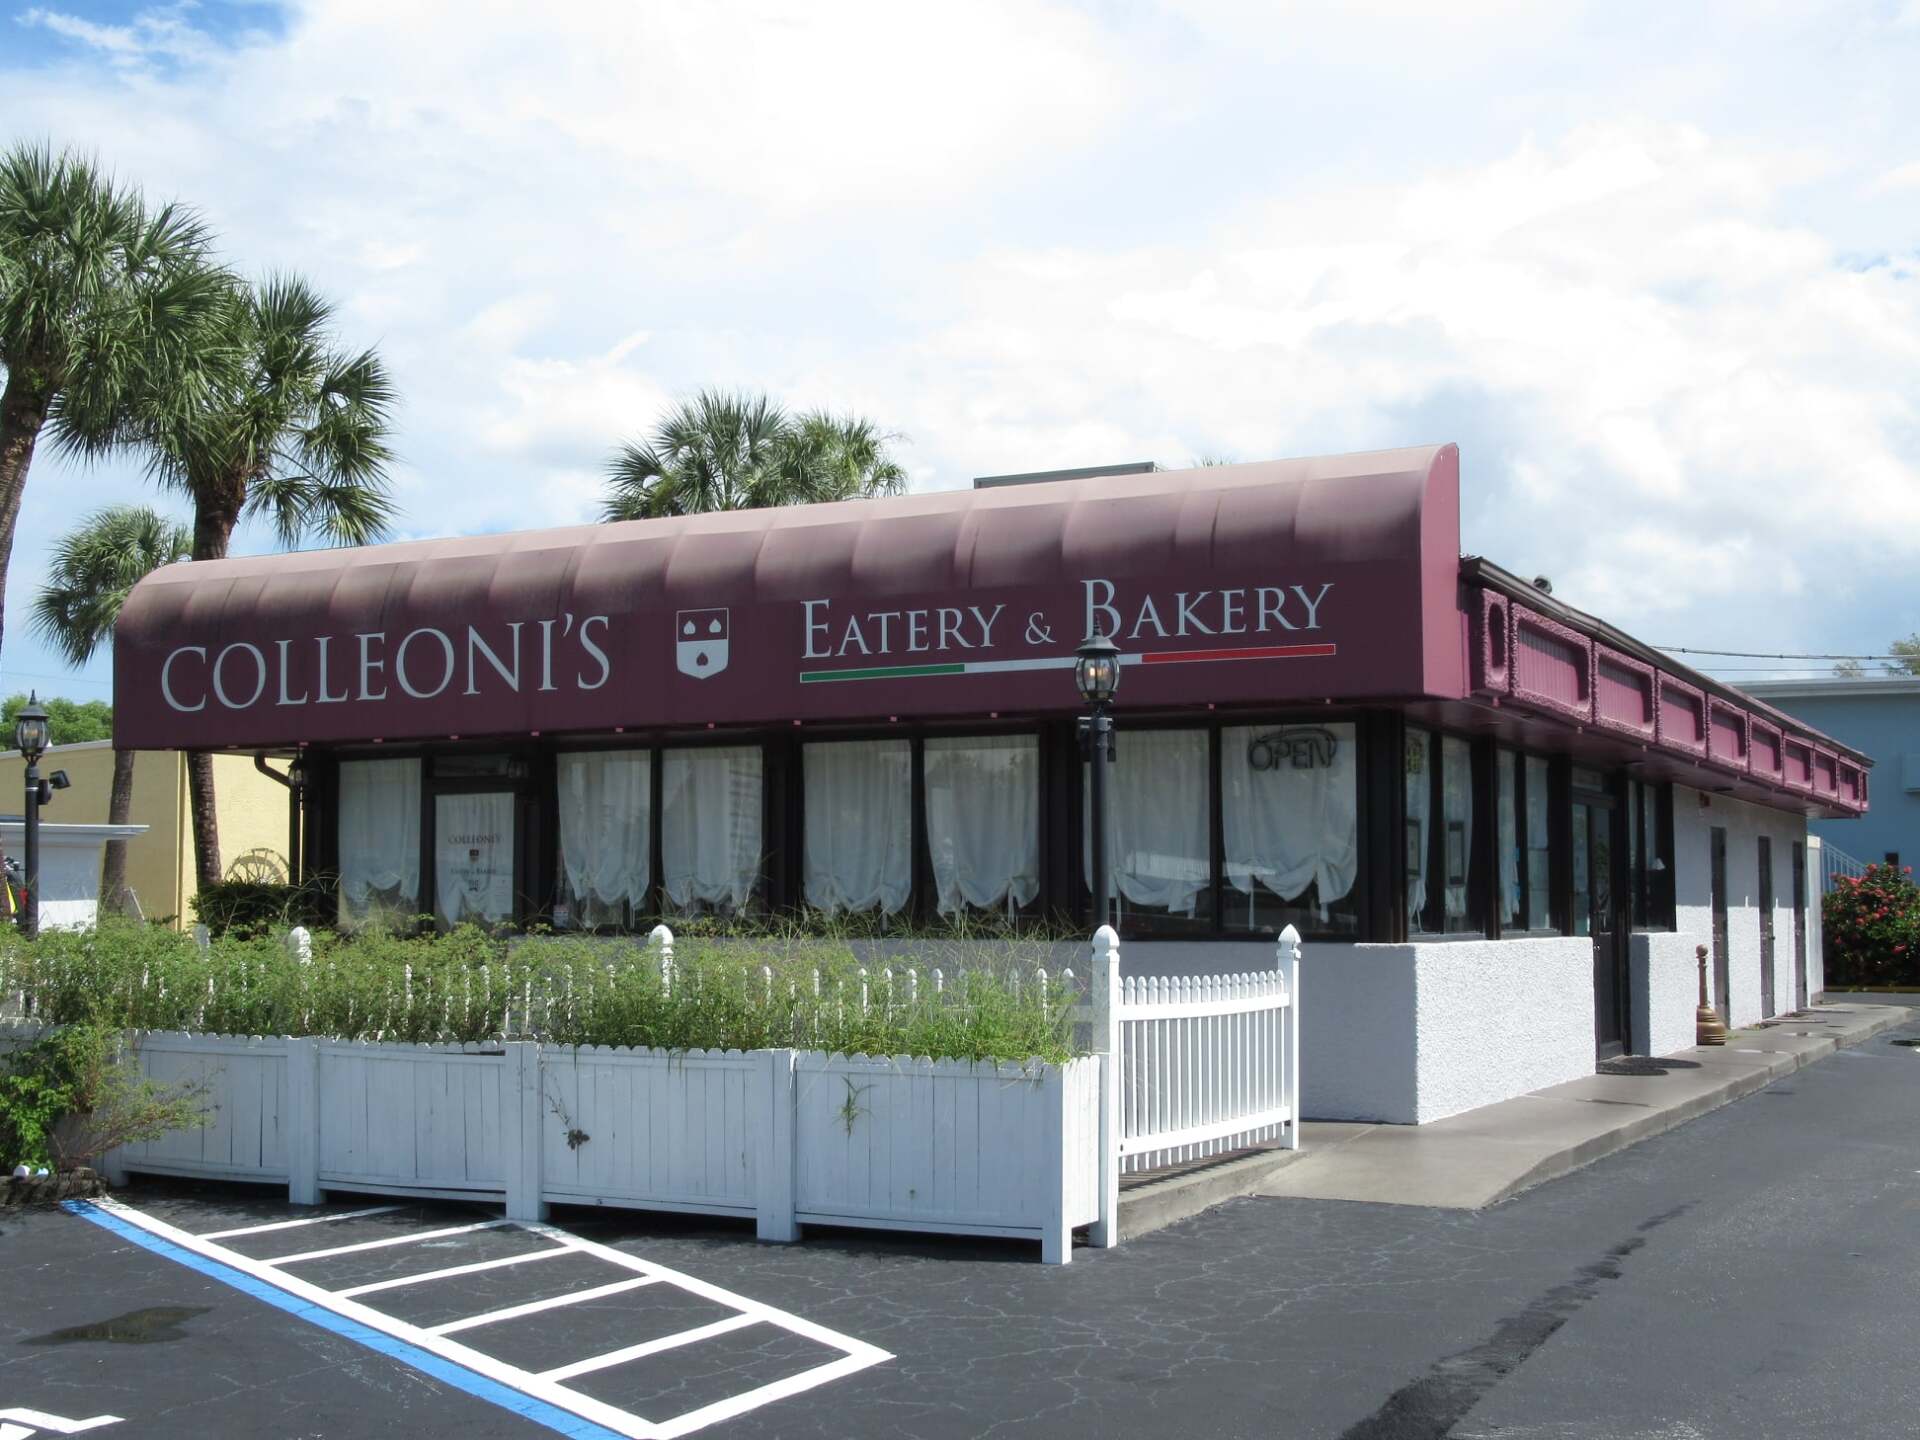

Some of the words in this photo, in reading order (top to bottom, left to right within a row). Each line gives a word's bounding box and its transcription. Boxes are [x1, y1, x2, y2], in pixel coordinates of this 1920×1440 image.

[802, 598, 1006, 659] EATERY
[1024, 612, 1057, 645] &
[1081, 578, 1335, 643] BAKERY
[161, 613, 611, 712] COLLEONI'S
[1248, 738, 1335, 771] OPEN
